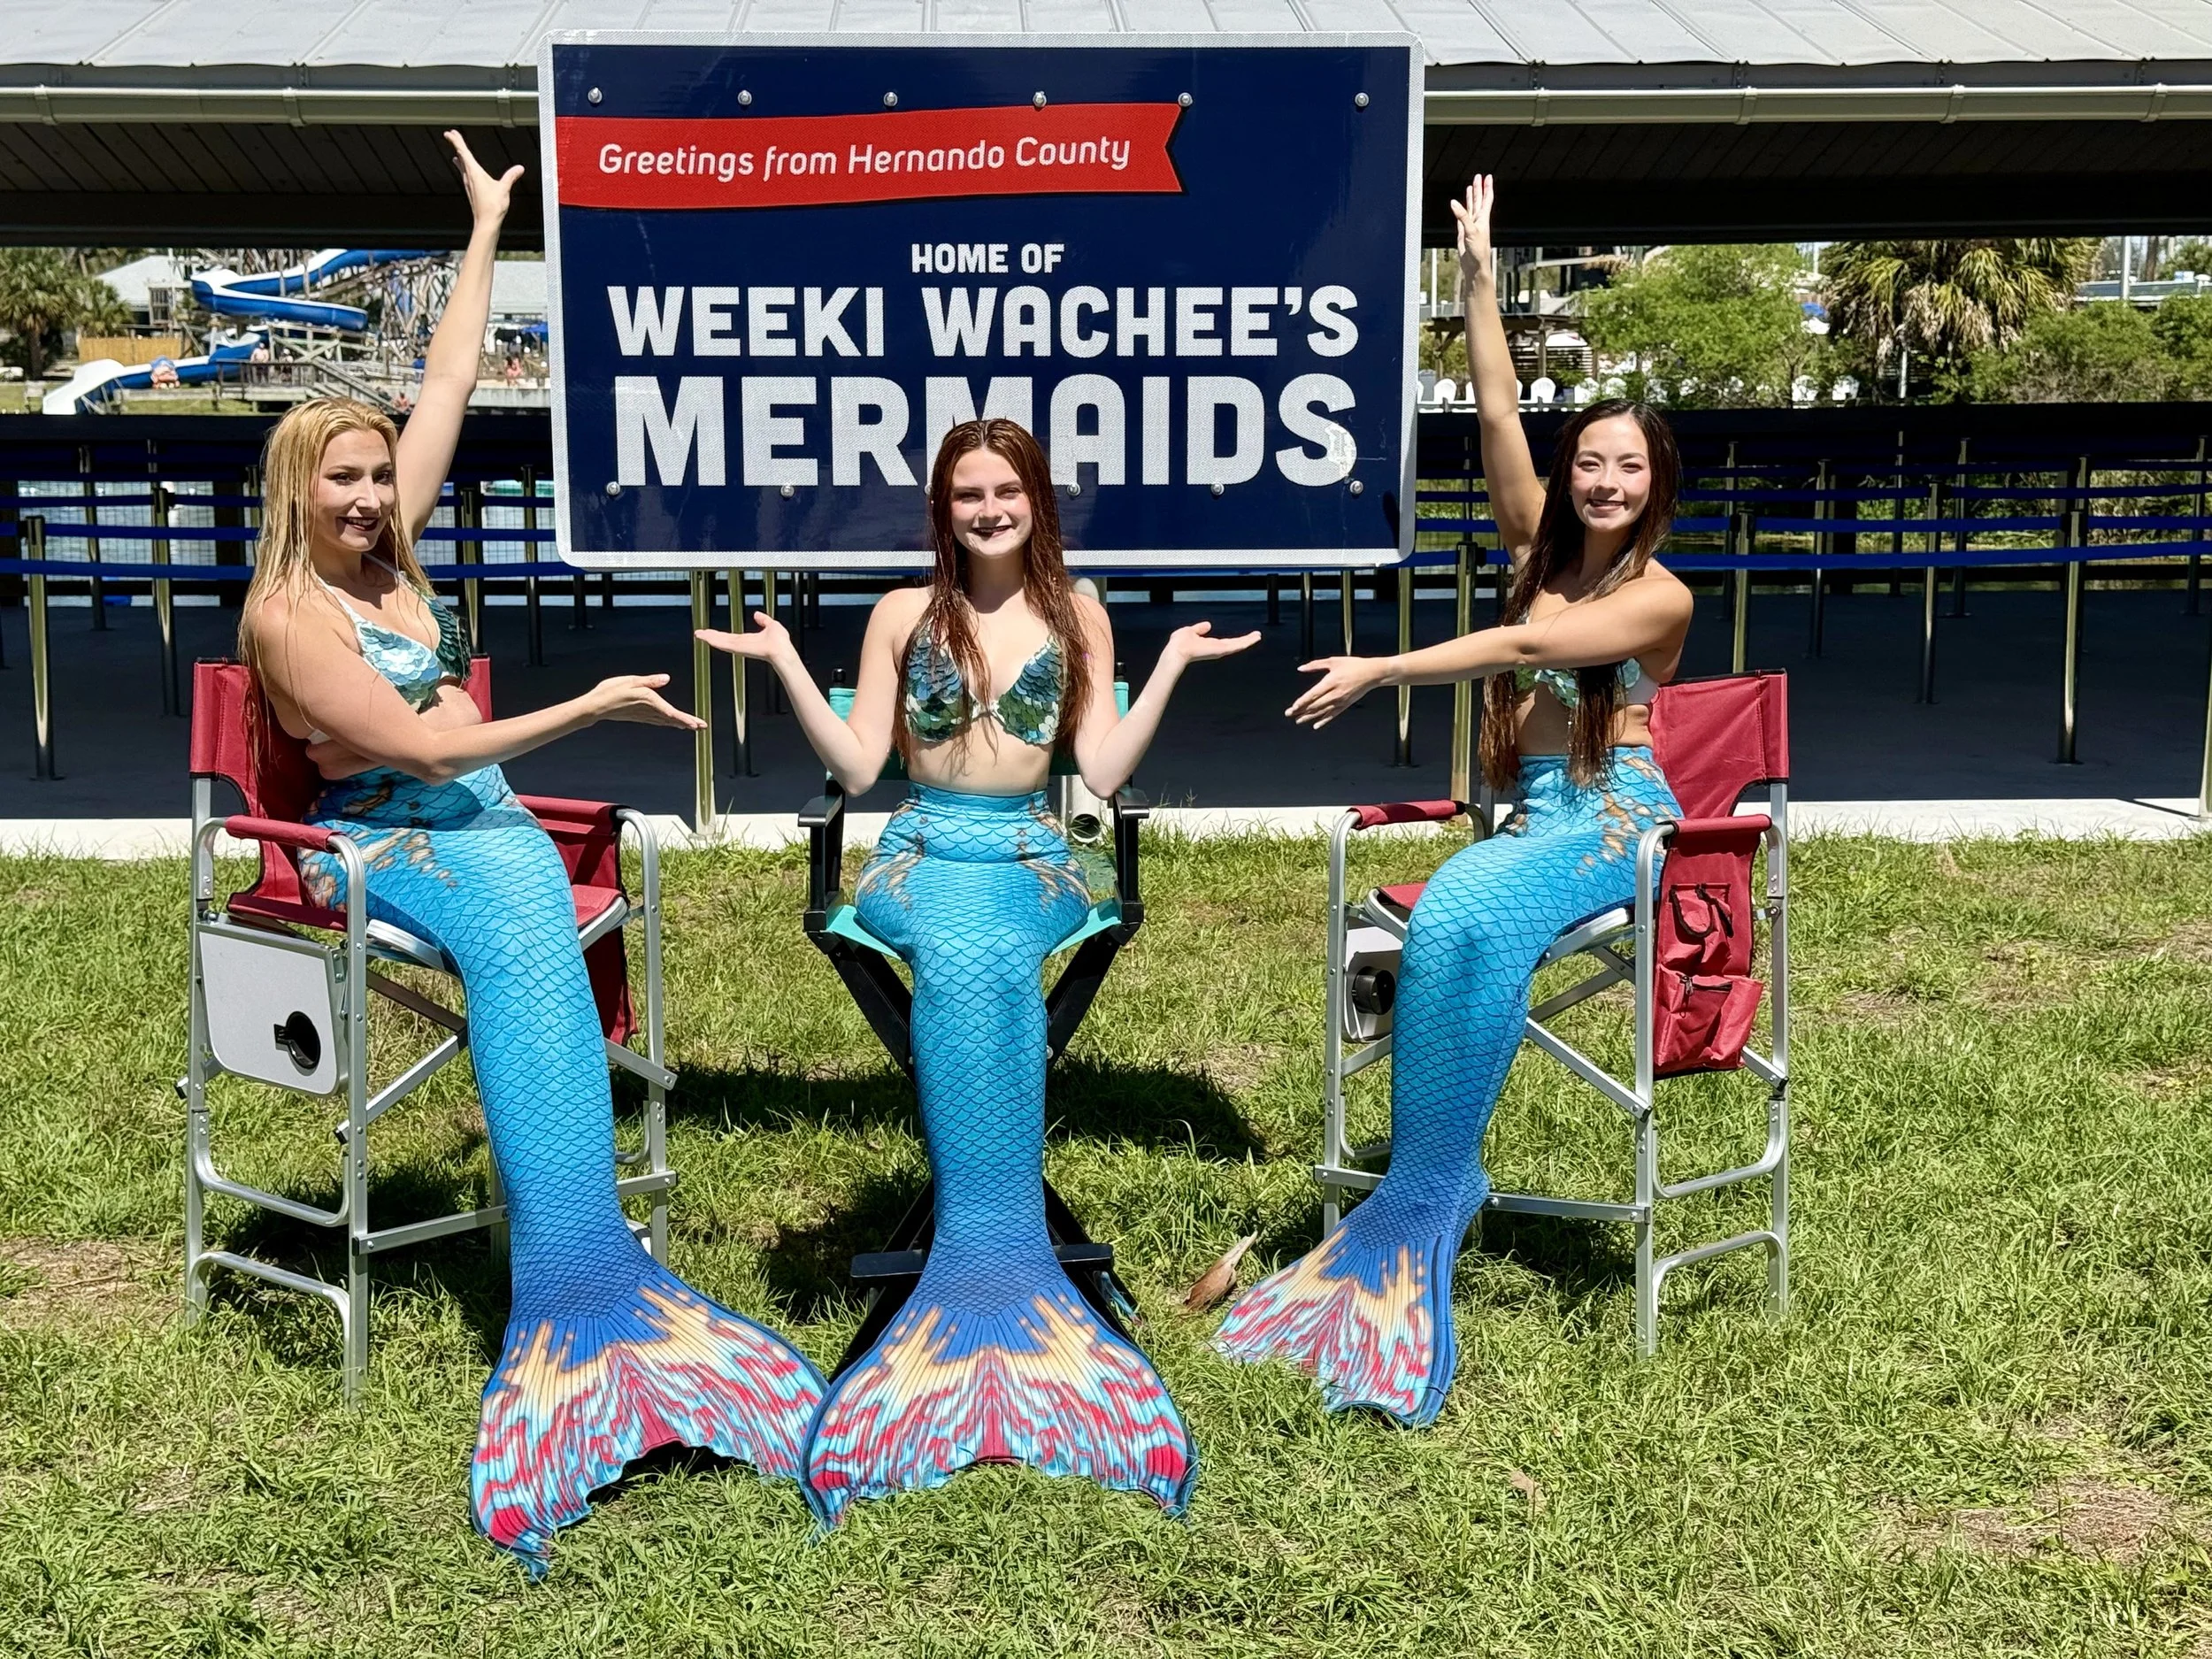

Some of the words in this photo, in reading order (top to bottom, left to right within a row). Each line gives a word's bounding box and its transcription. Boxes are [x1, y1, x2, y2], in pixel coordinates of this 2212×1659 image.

[599, 143, 754, 182] Greetings
[764, 146, 837, 180] from
[849, 141, 1004, 173] Hernando
[1016, 136, 1130, 170] County
[911, 243, 1009, 273] HOME
[1021, 243, 1064, 273] OF
[607, 286, 884, 357] WEEKI
[921, 285, 1359, 357] WACHEE'S
